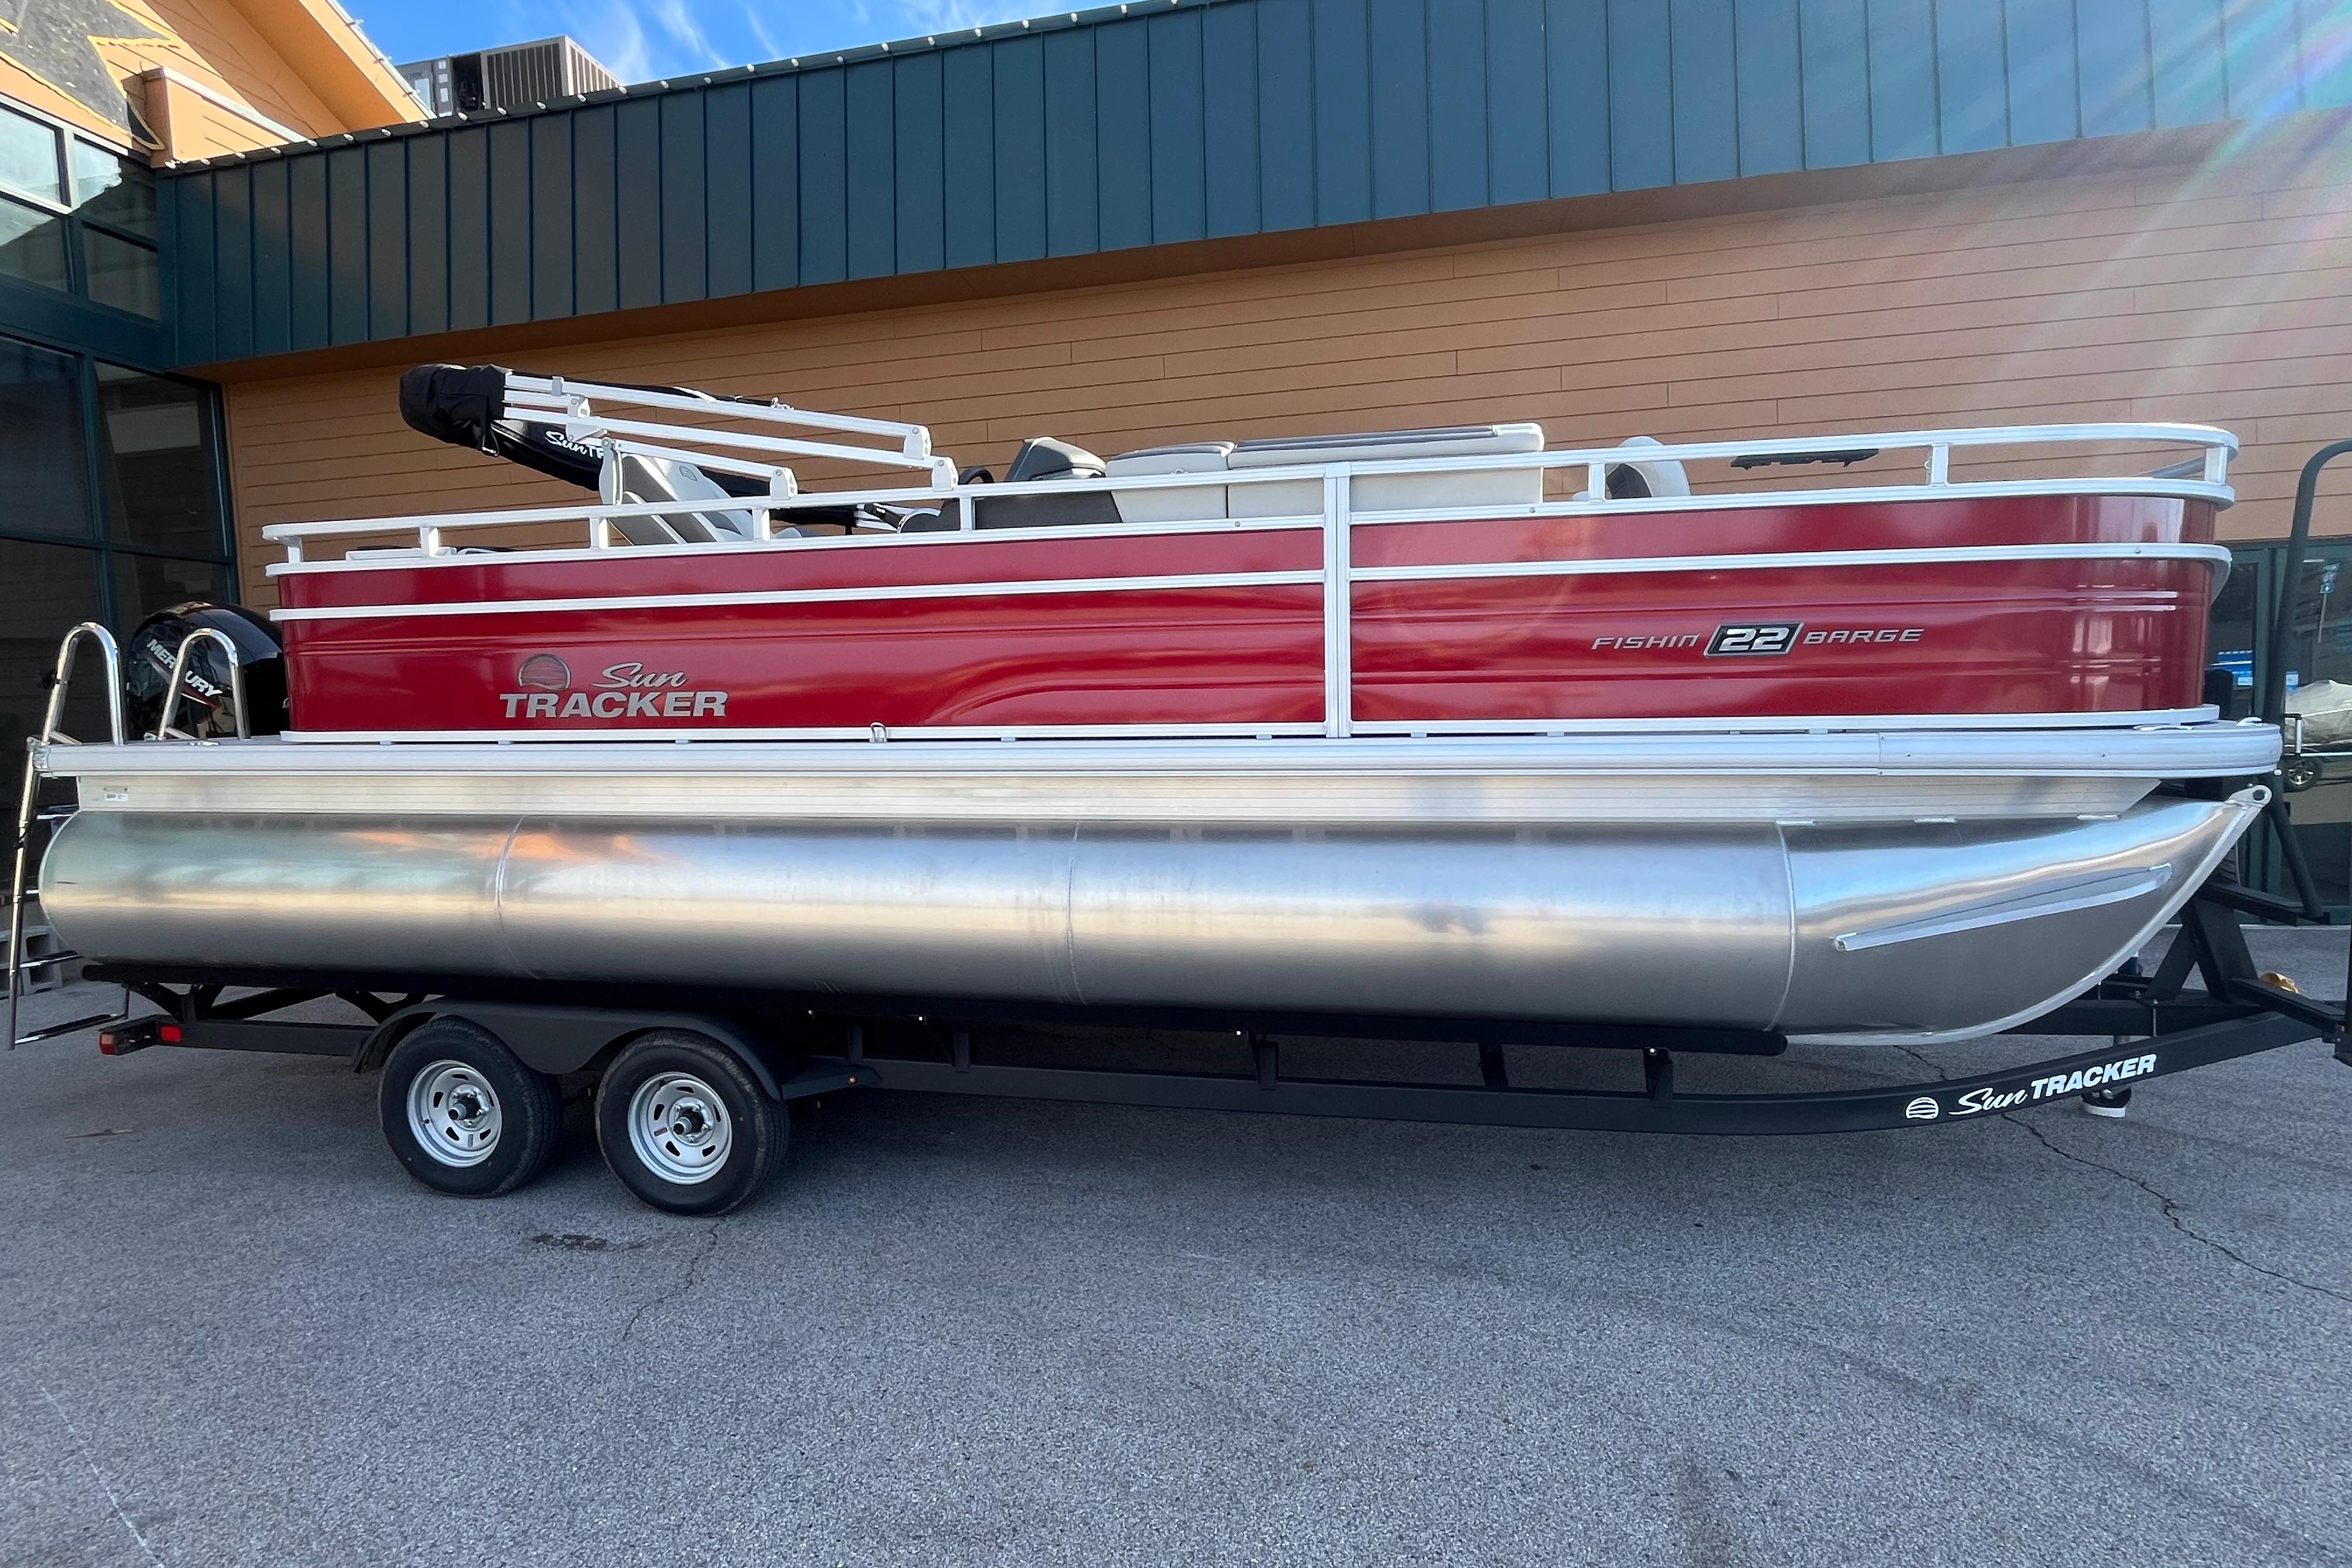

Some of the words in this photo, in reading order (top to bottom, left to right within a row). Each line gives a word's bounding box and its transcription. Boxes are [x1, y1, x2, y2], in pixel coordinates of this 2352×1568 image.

[544, 430, 588, 455] Sun
[1591, 633, 1700, 650] FISHIN
[1718, 627, 1791, 651] 22
[1803, 628, 1926, 645] BARGE
[146, 639, 223, 697] MERURY
[592, 662, 688, 688] Sun
[499, 691, 729, 718] TRACKER
[1948, 1087, 2030, 1116] Sun
[2031, 1054, 2157, 1100] TRACKER
